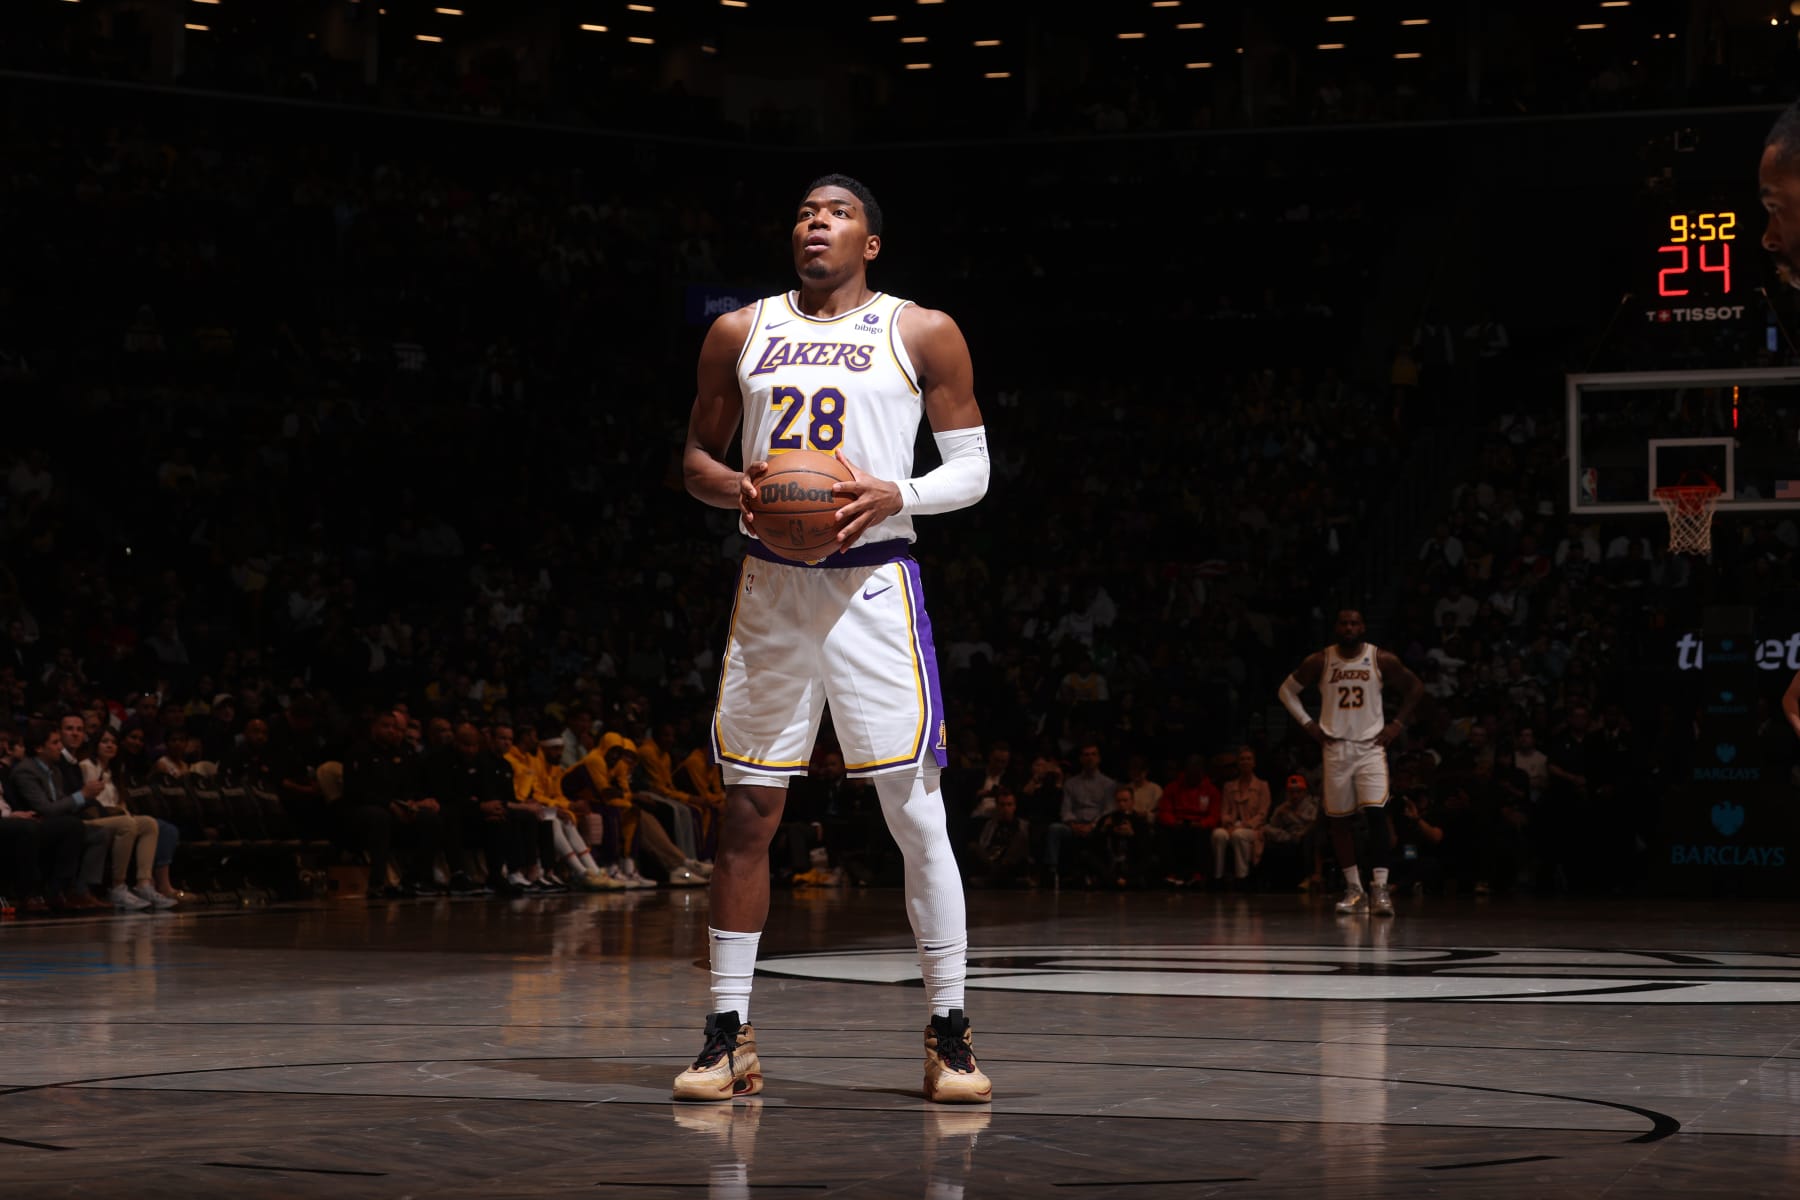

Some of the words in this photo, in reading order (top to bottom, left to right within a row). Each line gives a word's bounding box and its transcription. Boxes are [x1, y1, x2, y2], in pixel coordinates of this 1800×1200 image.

[1670, 212, 1736, 243] 9:52
[1658, 243, 1731, 297] 24
[1672, 306, 1745, 322] TISSOT
[854, 323, 883, 335] bibigo
[749, 336, 875, 378] LAKERS
[769, 385, 846, 455] 28
[760, 481, 835, 505] Wilson
[1328, 667, 1371, 684] LAKERS
[1338, 686, 1364, 709] 23
[1693, 767, 1760, 782] BARCLAYS
[1670, 844, 1786, 866] BARCLAYS
